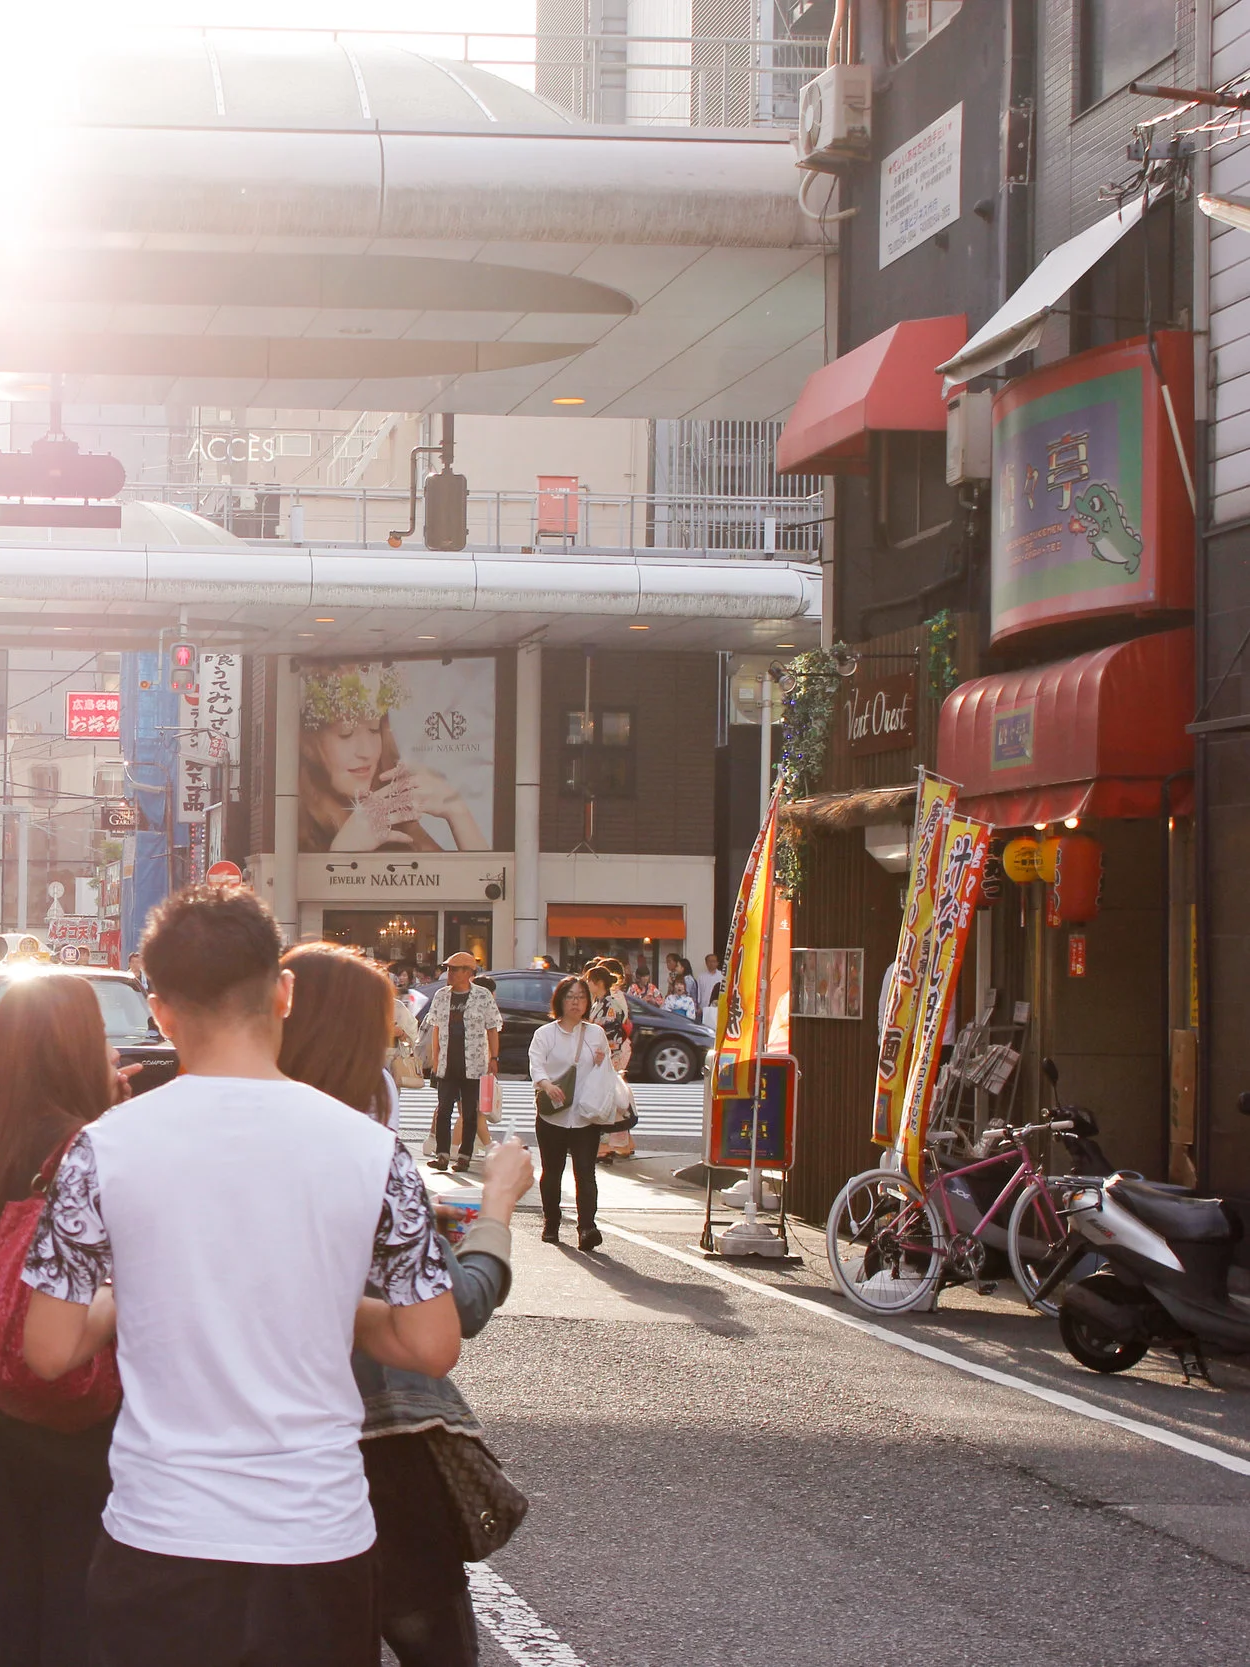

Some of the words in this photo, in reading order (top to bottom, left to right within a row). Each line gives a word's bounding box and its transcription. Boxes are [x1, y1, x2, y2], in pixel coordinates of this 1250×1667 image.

[72, 699, 119, 711] 広島名物
[843, 687, 871, 740] Vent
[872, 691, 912, 736] Ouest
[436, 744, 480, 753] NAKATANI
[329, 875, 366, 885] JEWELRY
[370, 873, 441, 887] NAKATANI
